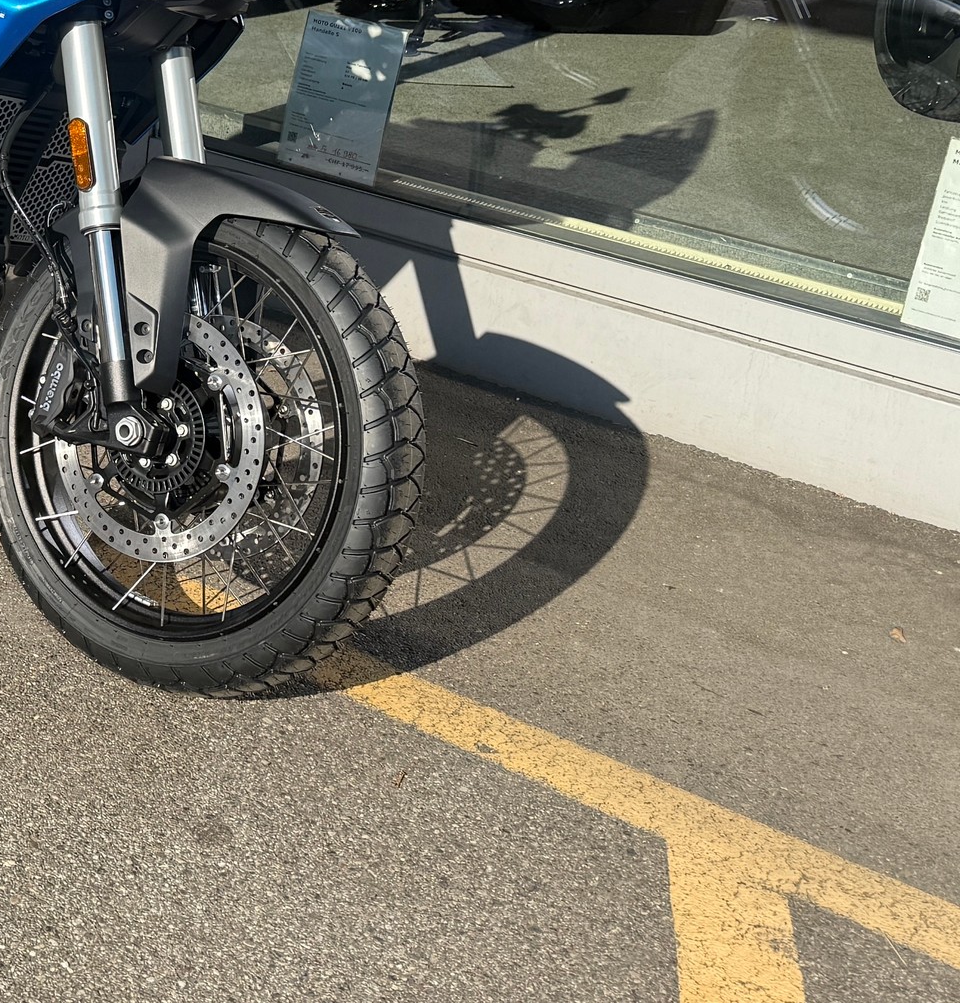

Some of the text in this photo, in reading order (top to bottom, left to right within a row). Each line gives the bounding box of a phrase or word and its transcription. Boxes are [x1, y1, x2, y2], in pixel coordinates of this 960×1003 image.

[313, 18, 329, 27] MOTO
[311, 26, 335, 37] Mandello
[40, 362, 64, 413] brembo
